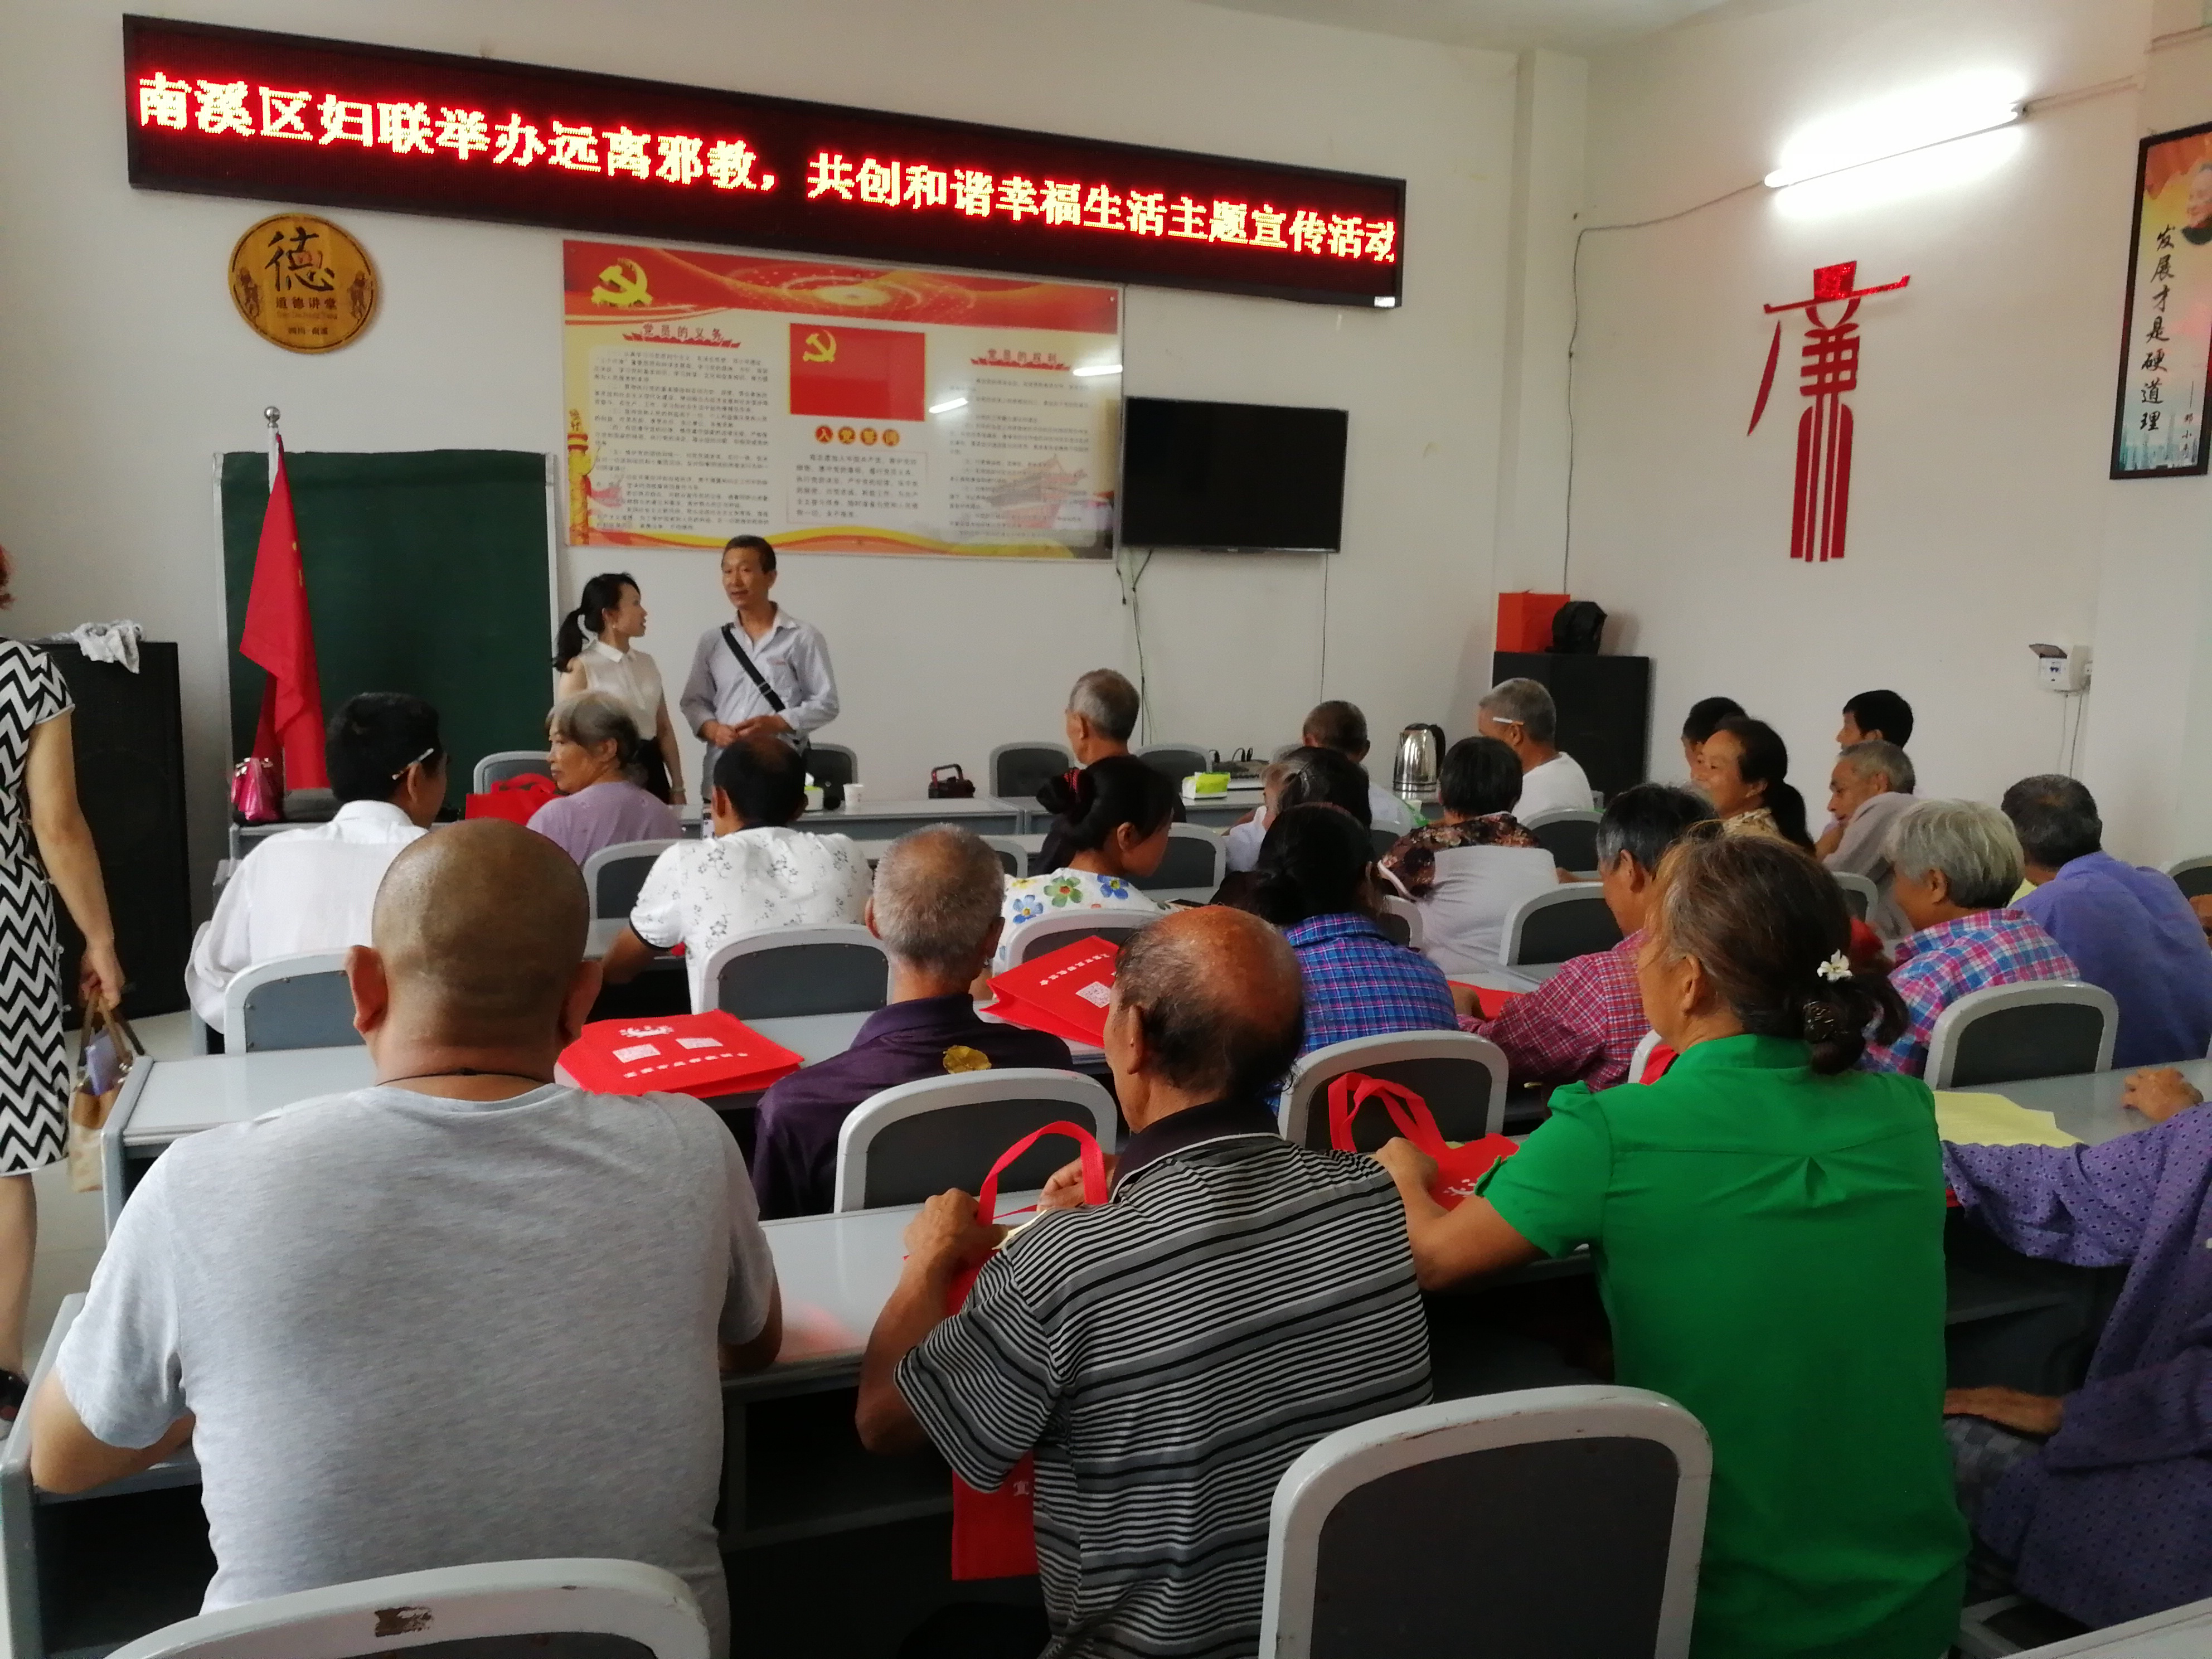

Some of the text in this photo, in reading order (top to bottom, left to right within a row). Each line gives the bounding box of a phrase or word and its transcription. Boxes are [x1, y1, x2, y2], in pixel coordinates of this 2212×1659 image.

[643, 322, 725, 342] 党员的义务
[2139, 224, 2176, 432] 发展才是硬道理
